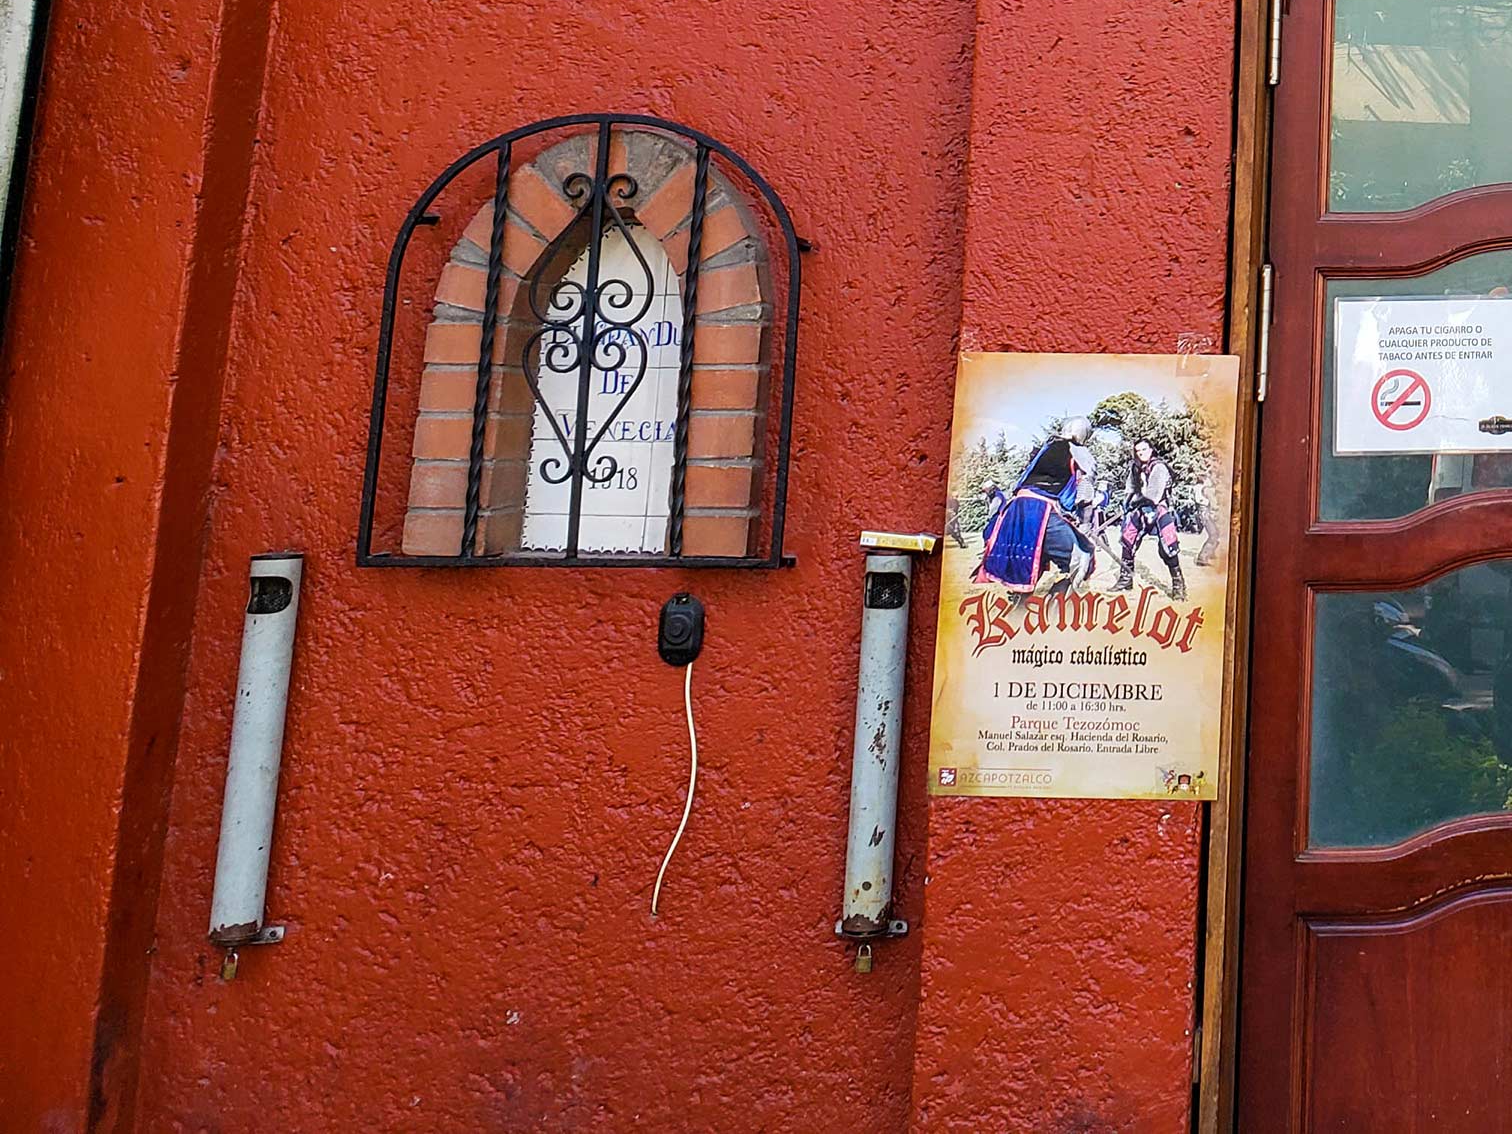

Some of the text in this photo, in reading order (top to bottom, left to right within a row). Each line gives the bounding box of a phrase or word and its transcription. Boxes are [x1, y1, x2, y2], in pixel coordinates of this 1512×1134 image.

[1388, 325, 1483, 335] APAGA TU CIGARRO O
[1379, 338, 1492, 348] CUALQUIER PRODUCTO DE
[1378, 350, 1493, 361] TABACO ANTES DE ENTRAR
[959, 584, 1206, 657] Kamelot
[1012, 644, 1147, 667] mágico cabalístico
[993, 682, 1163, 701] 1 DE DICIEMBRE
[1026, 700, 1127, 713] de 11:00 a 16:30 hrs.
[1011, 716, 1141, 733] Parque Tezozómoc
[978, 730, 1013, 741] Manuel
[1014, 731, 1049, 741] Salazar
[1070, 732, 1113, 743] Hacienda
[1115, 732, 1129, 743] del
[1131, 733, 1169, 745] Rosario,
[986, 742, 1005, 752] Col.
[1008, 743, 1039, 753] Prados
[1041, 742, 1055, 753] del
[1096, 744, 1132, 755] Entrada
[1134, 744, 1158, 755] Libre
[960, 772, 1053, 785] AZCAPOTZALCO
